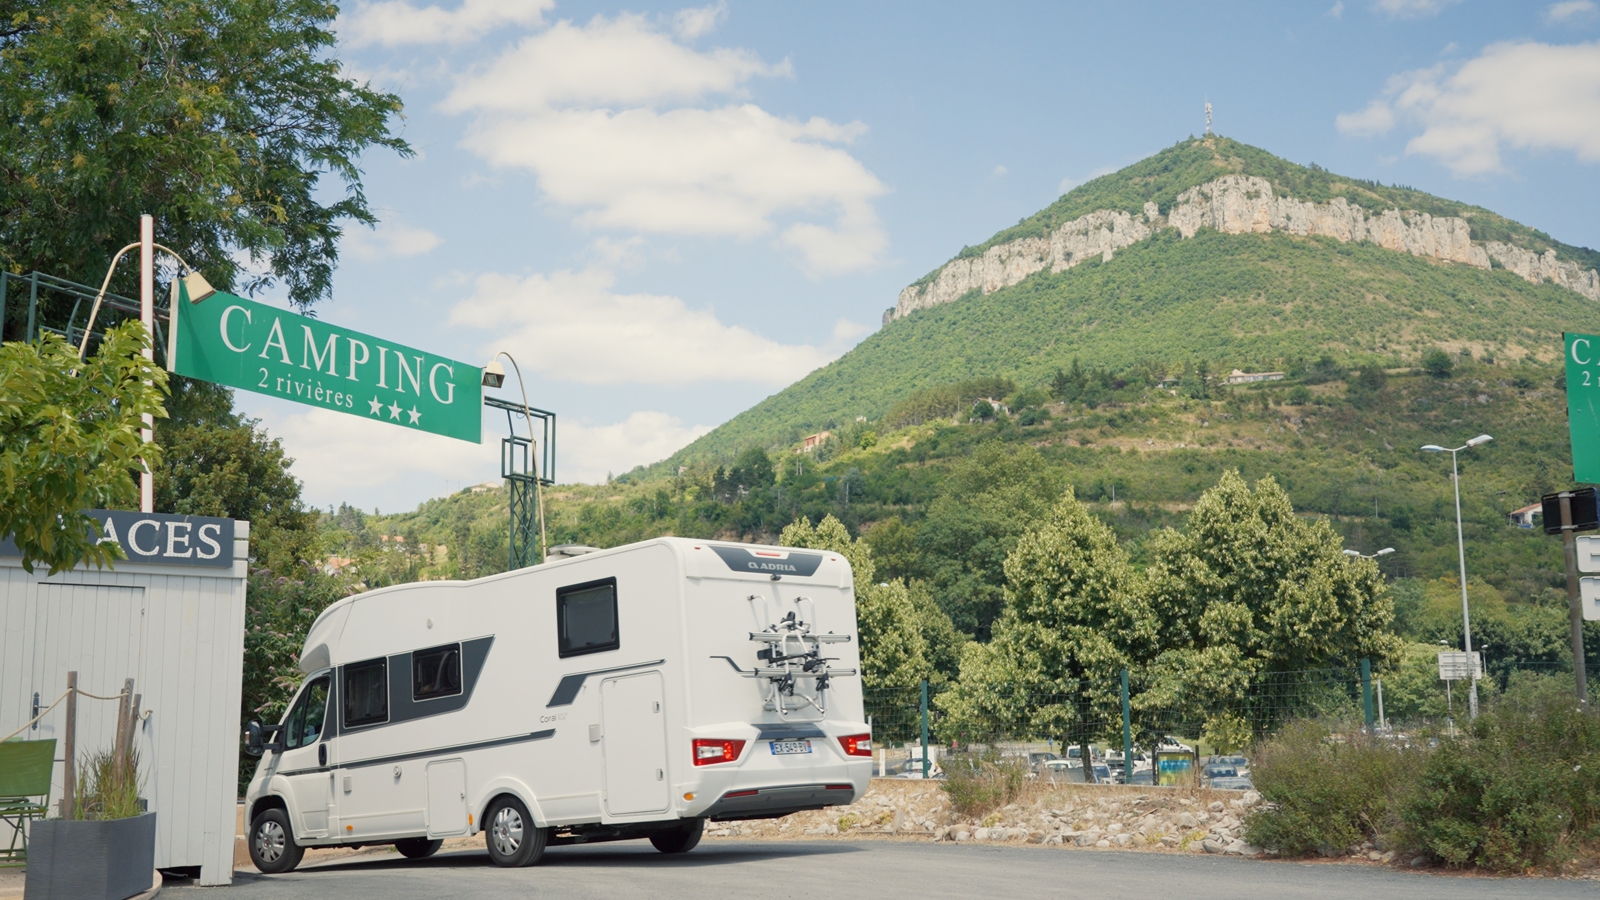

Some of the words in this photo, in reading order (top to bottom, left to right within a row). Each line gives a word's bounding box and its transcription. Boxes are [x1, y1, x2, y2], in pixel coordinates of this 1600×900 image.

[219, 304, 456, 405] CAMPING
[1571, 338, 1600, 366] C
[258, 367, 269, 388] 2
[276, 373, 354, 408] rivières
[1581, 370, 1592, 386] 2
[760, 562, 797, 572] ADRIA
[540, 714, 557, 724] Coral
